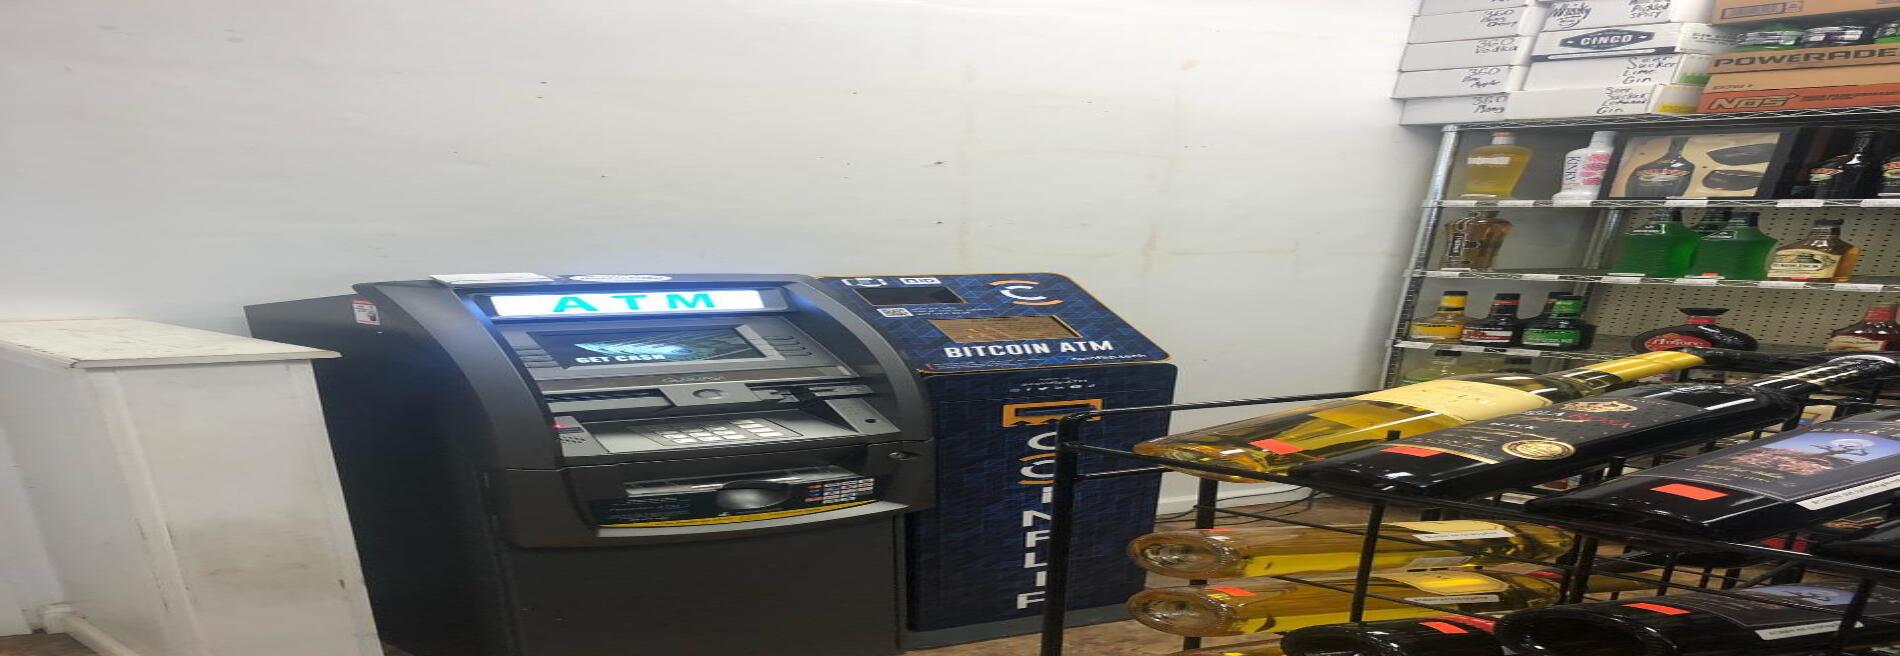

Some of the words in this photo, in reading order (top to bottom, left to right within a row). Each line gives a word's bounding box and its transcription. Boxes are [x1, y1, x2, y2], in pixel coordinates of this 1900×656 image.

[1580, 34, 1633, 46] CINCO
[1713, 48, 1899, 67] POWERADE
[1622, 76, 1652, 84] Gin
[1708, 93, 1798, 110] NOS
[1596, 106, 1625, 114] Gin
[552, 292, 717, 313] ATM
[943, 342, 1052, 358] BITCOIN
[1059, 341, 1115, 353] ATM
[575, 356, 611, 364] GET
[615, 354, 667, 362] CASH
